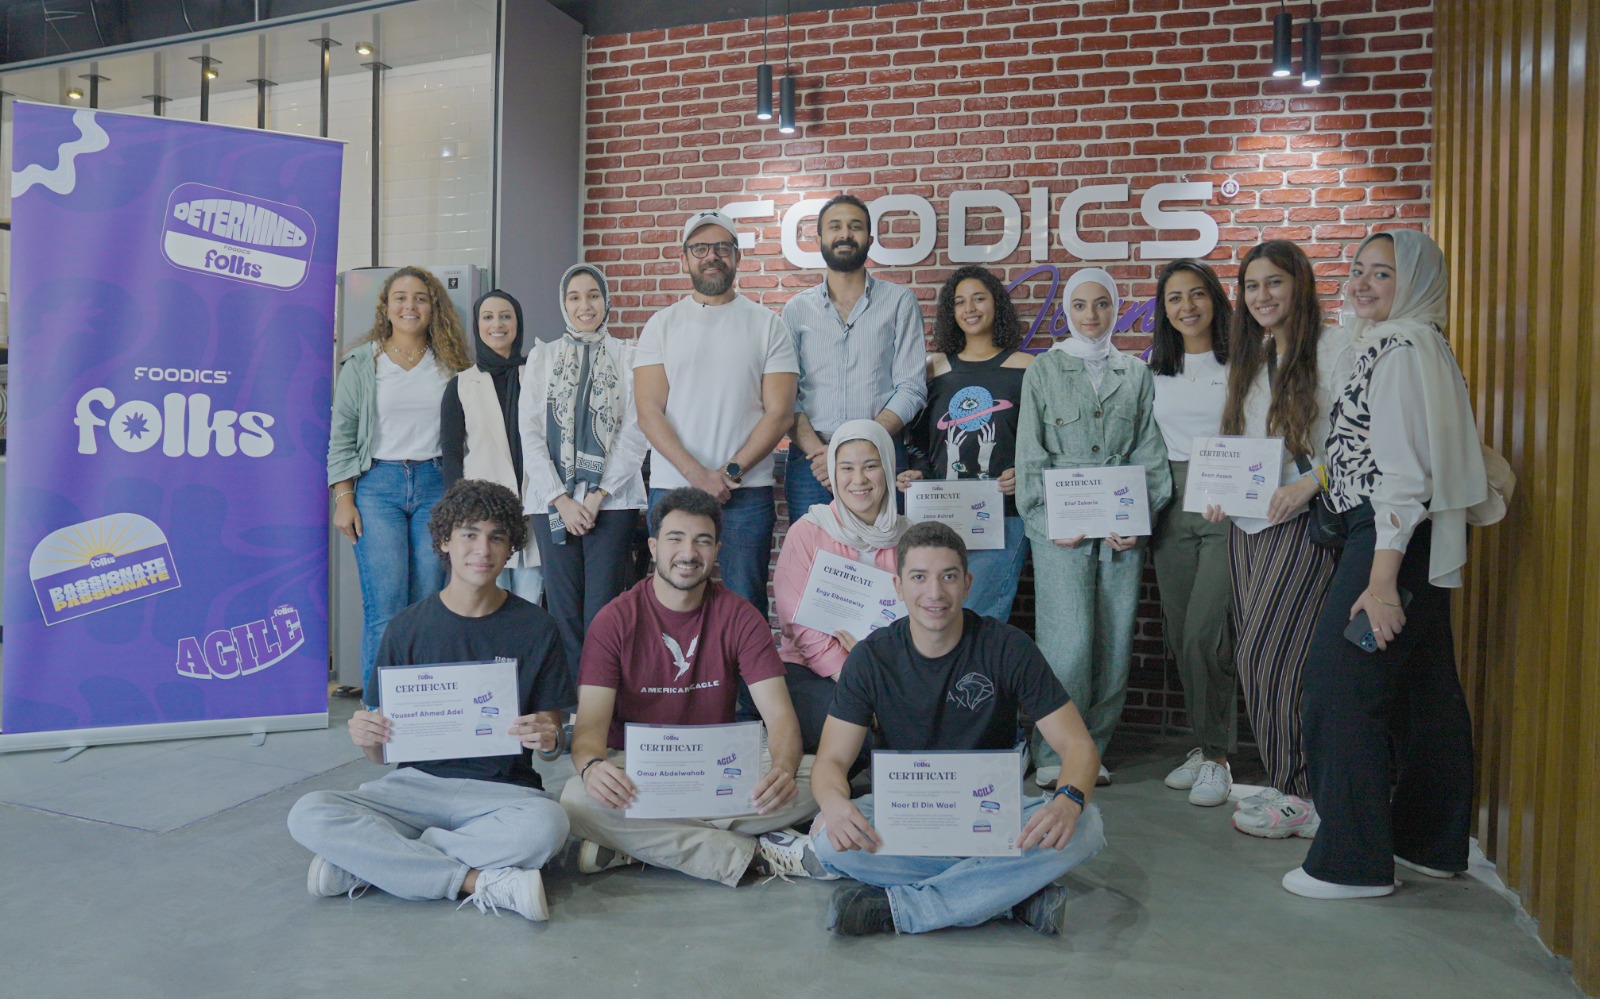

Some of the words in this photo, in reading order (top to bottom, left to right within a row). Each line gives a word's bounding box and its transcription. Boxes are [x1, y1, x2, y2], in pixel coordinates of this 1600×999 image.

[173, 198, 307, 247] DETERMINED
[205, 249, 263, 278] folks
[134, 367, 227, 384] FOODICS
[73, 387, 275, 458] folks
[1199, 450, 1241, 459] CERTIFICATE
[1055, 479, 1102, 488] CERTIFICATE
[823, 565, 874, 588] CERTIFICATE
[176, 610, 305, 680] AGILE
[395, 682, 459, 694] CERTIFICATE
[391, 709, 418, 719] Youssef
[419, 709, 445, 718] Ahmed
[446, 708, 464, 717] Adel
[640, 743, 704, 752] CERTIFICATE
[659, 769, 706, 777] Abdelwahab
[888, 771, 957, 781] CERTIFICATE
[891, 801, 910, 809] Noor
[912, 801, 919, 809] El
[921, 801, 934, 809] Din
[936, 801, 957, 809] Wael
